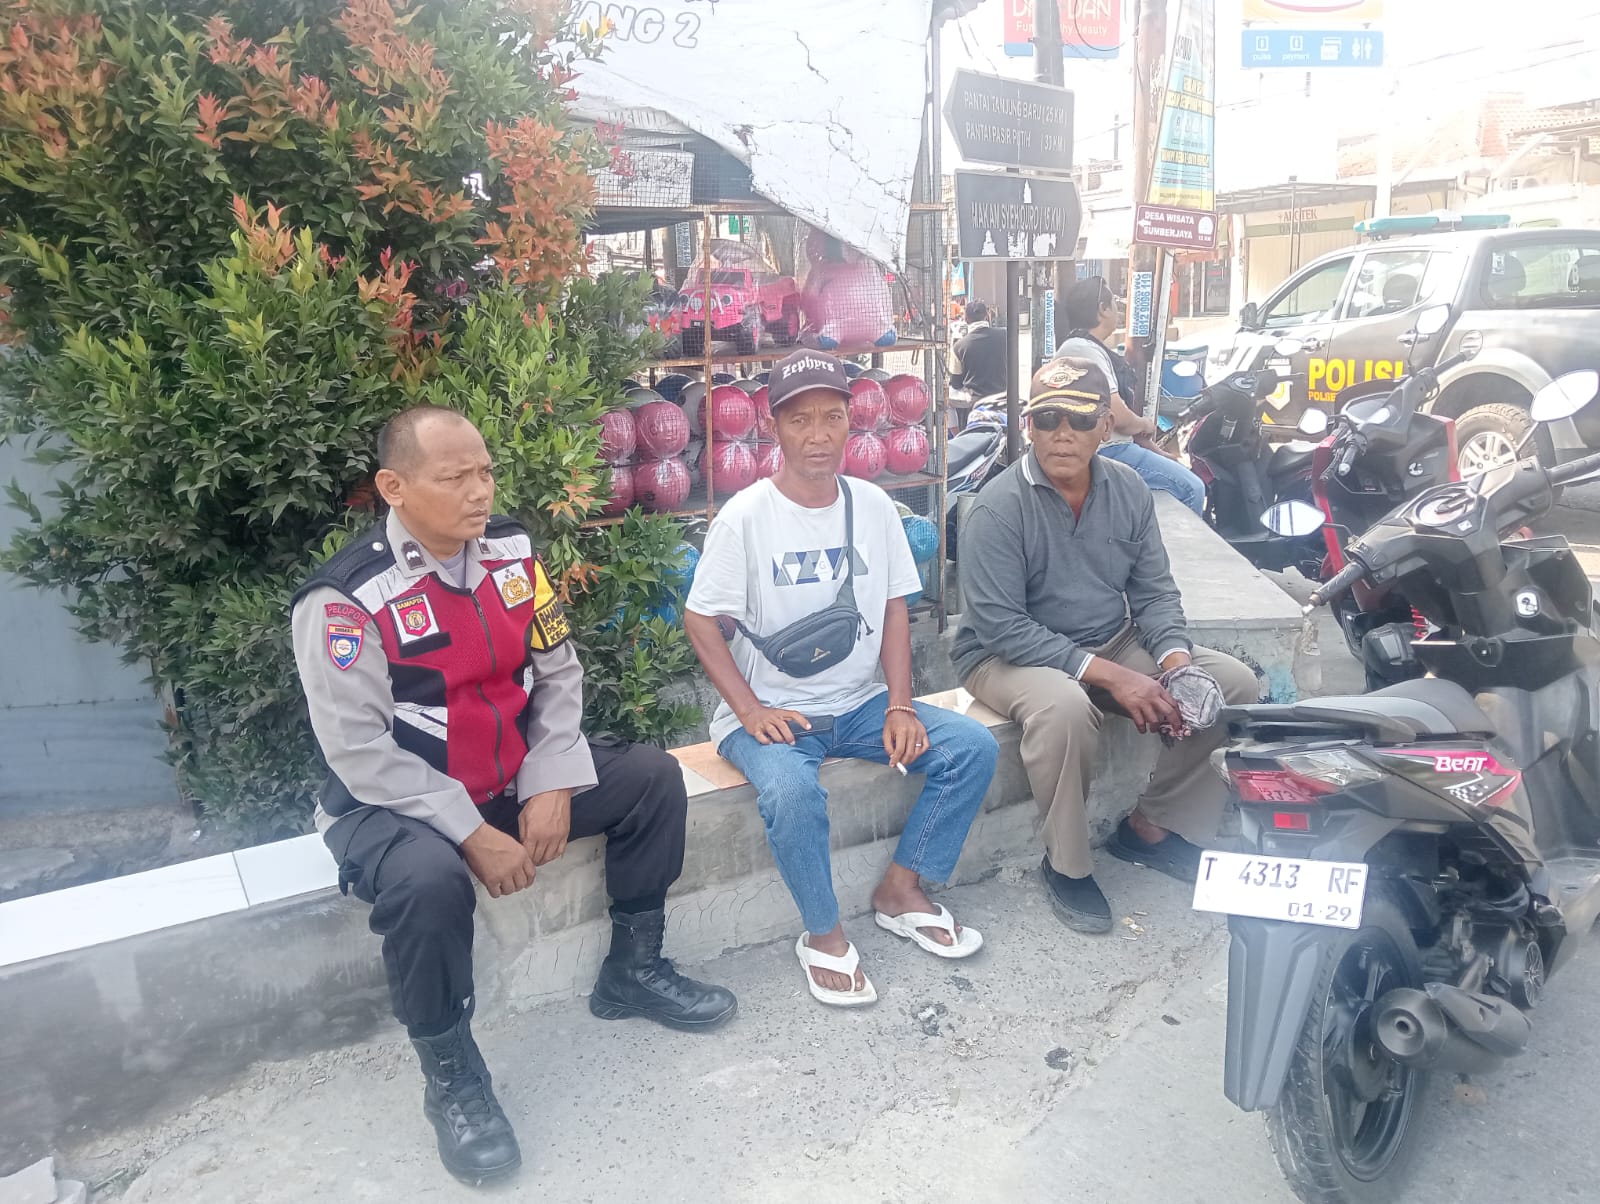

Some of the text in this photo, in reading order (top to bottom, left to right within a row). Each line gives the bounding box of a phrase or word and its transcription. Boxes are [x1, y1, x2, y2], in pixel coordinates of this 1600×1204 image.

[673, 12, 701, 48] 2
[964, 91, 990, 113] PANTAI
[991, 96, 1022, 117] TANJUNG
[1022, 103, 1041, 121] BARU
[965, 121, 991, 141] PANTAI
[992, 126, 1011, 145] PASIR
[1012, 130, 1031, 148] PUTIH
[971, 202, 999, 229] MAKAM
[1001, 203, 1019, 229] SYEH
[1144, 211, 1195, 225] DESA WISATA
[1143, 225, 1193, 240] SUMBERJAYA
[1046, 292, 1053, 309] WC
[1138, 314, 1149, 336] 0812
[782, 356, 835, 380] Zephyrs
[1308, 358, 1404, 391] POLISI
[1308, 391, 1337, 401] POLSE
[327, 605, 369, 626] PELOPOR
[1204, 857, 1362, 896] T 4313 RF
